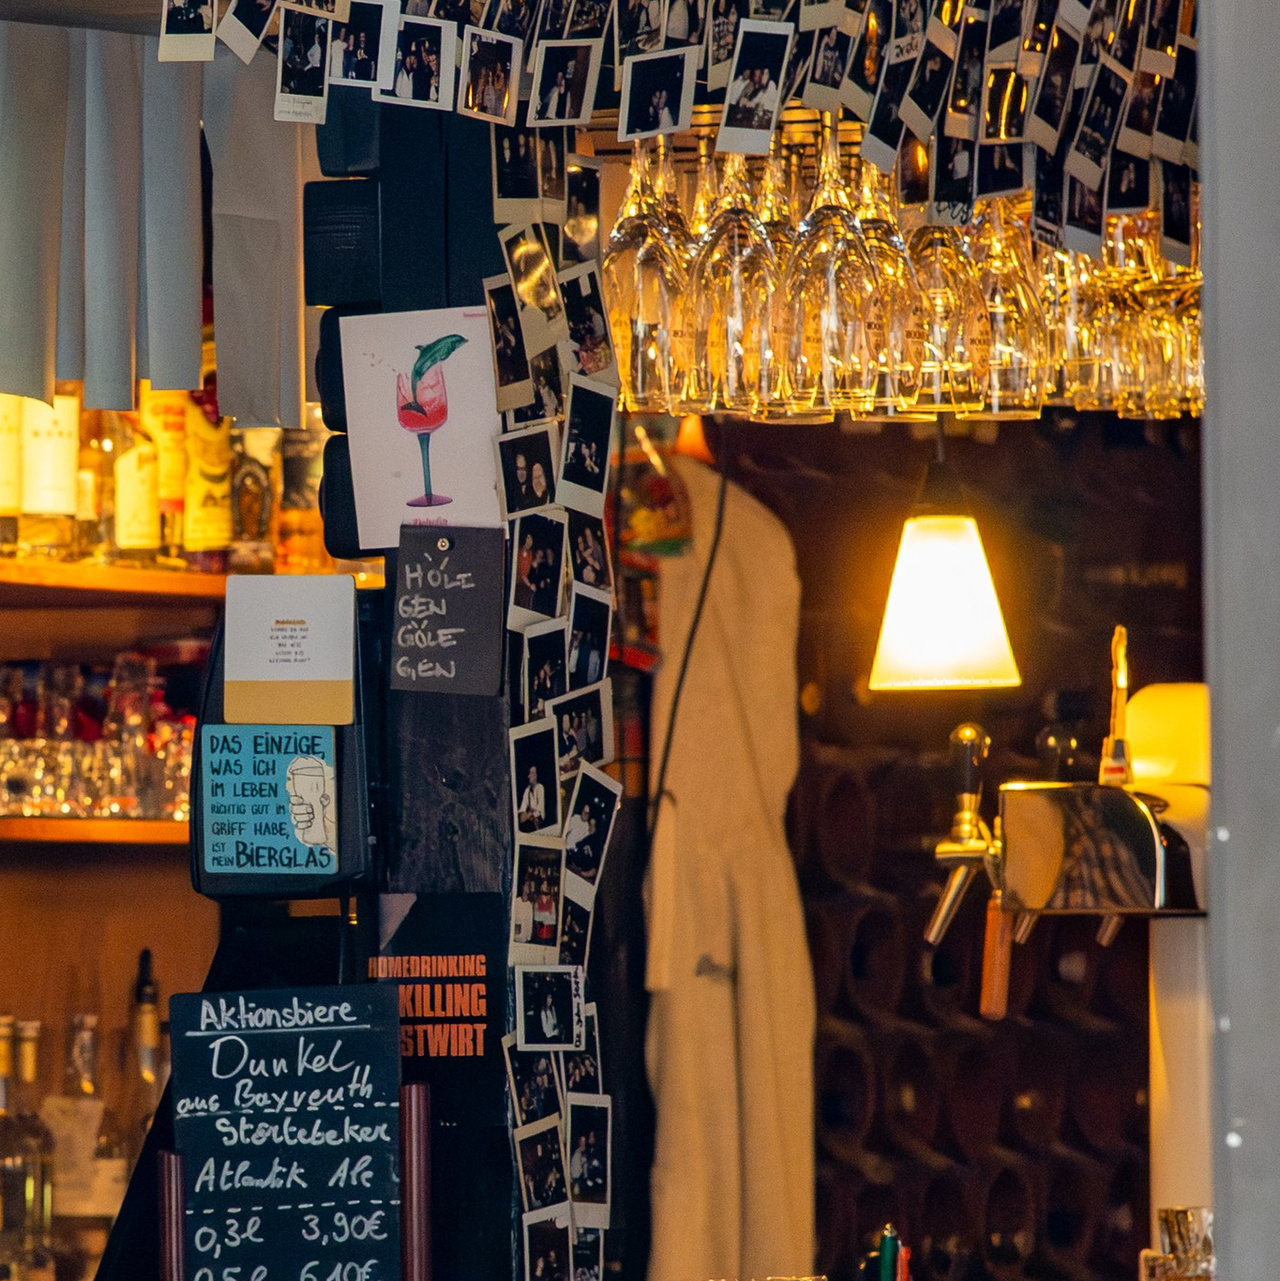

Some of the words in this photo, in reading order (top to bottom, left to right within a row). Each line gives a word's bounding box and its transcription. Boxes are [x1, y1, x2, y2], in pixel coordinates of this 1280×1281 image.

[210, 734, 243, 755] DAS
[210, 758, 243, 776] WAS
[233, 781, 279, 798] LEBEN
[251, 803, 271, 816] GUT
[253, 821, 291, 841] HABE,
[367, 954, 487, 979] HOMEDRINKING
[398, 983, 488, 1018] KILLING
[199, 995, 358, 1032] Aktionsbiere
[209, 1035, 356, 1080] Dunkel
[176, 1094, 221, 1115] aus
[328, 1154, 375, 1189] Ale
[301, 1210, 389, 1246] 3,90€
